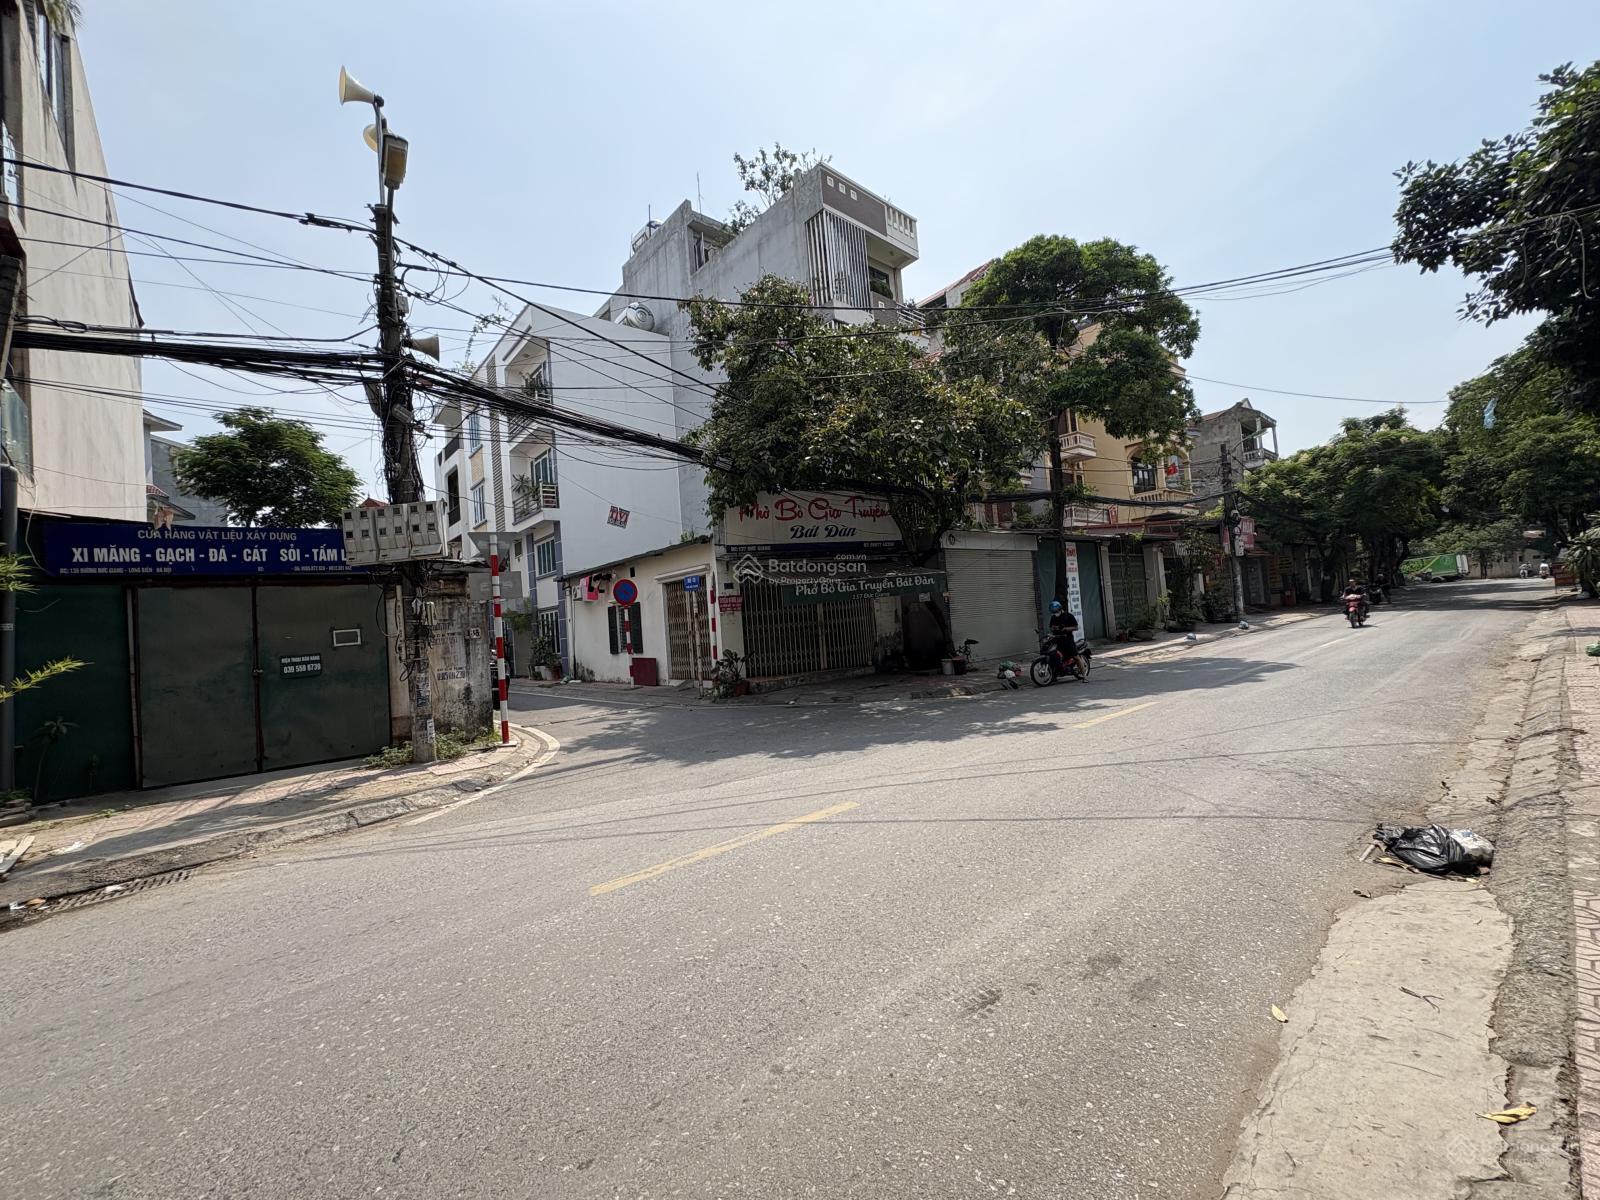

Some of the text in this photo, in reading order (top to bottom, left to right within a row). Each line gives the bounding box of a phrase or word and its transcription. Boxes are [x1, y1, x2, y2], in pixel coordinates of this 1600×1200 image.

[775, 498, 803, 521] Bò
[807, 497, 842, 521] Gia
[137, 527, 297, 542] CỬA HÀNG VẬT LIỆU XÂY DỰNG
[825, 524, 857, 538] Đàn
[72, 548, 88, 562] XI
[93, 544, 141, 562] MĂNG
[155, 548, 195, 565] GẠCH
[208, 545, 228, 562] ĐÁ
[242, 545, 268, 562] CÁT
[280, 543, 300, 562] SỎI
[312, 544, 338, 562] TẤM
[820, 583, 835, 594] Bò
[837, 582, 857, 593] Gia
[858, 579, 894, 593] Truyền
[896, 577, 913, 588] Bát
[914, 575, 935, 586] Đàn
